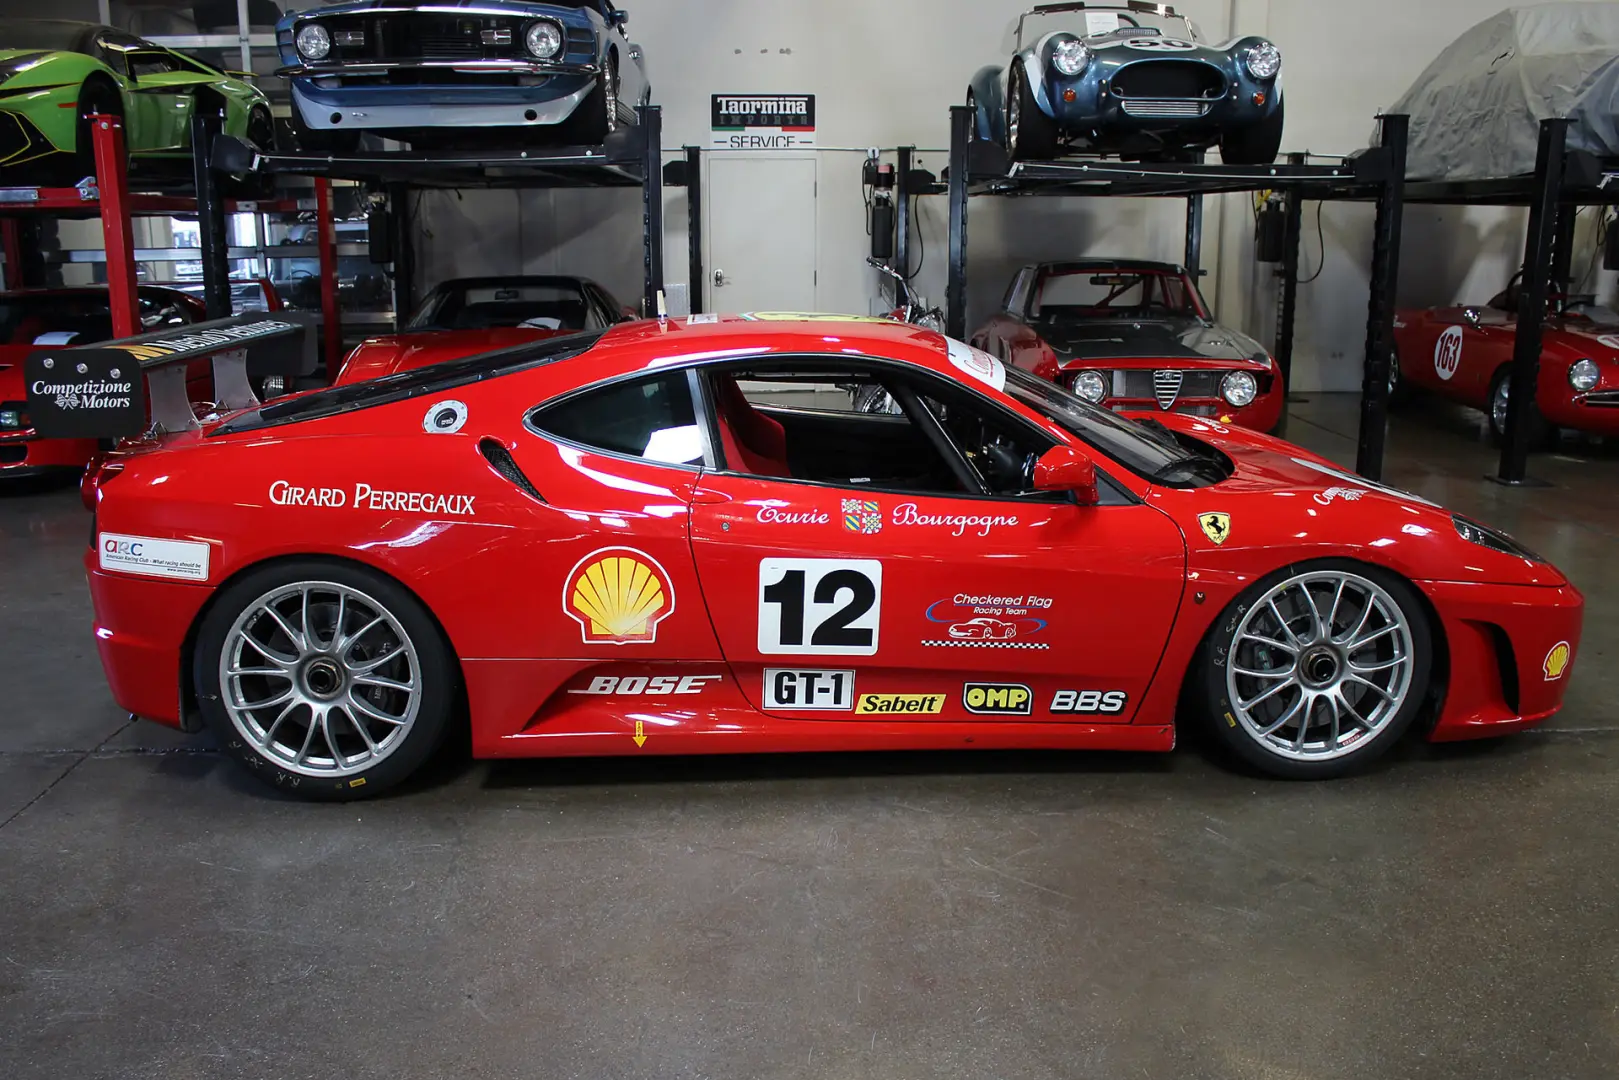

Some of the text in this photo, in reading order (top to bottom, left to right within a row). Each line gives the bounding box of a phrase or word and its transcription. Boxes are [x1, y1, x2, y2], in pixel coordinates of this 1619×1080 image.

[717, 97, 808, 114] Taormina
[720, 115, 808, 125] IMPORTS
[1437, 333, 1460, 373] 163
[32, 379, 131, 398] Competizione
[80, 394, 131, 409] Motors
[268, 480, 476, 515] GIRARD PERREGAUX
[892, 502, 1019, 537] Bourgogne
[124, 555, 138, 563] Racing
[165, 560, 179, 568] racing
[764, 569, 876, 647] 12
[953, 593, 1053, 609] Checkered Flag
[973, 606, 1027, 616] Racing Team
[568, 675, 722, 695] BOSE
[774, 671, 845, 706] GT-1
[863, 695, 938, 713] Sabelt
[967, 688, 1028, 709] OMP
[1049, 690, 1127, 714] BBS
